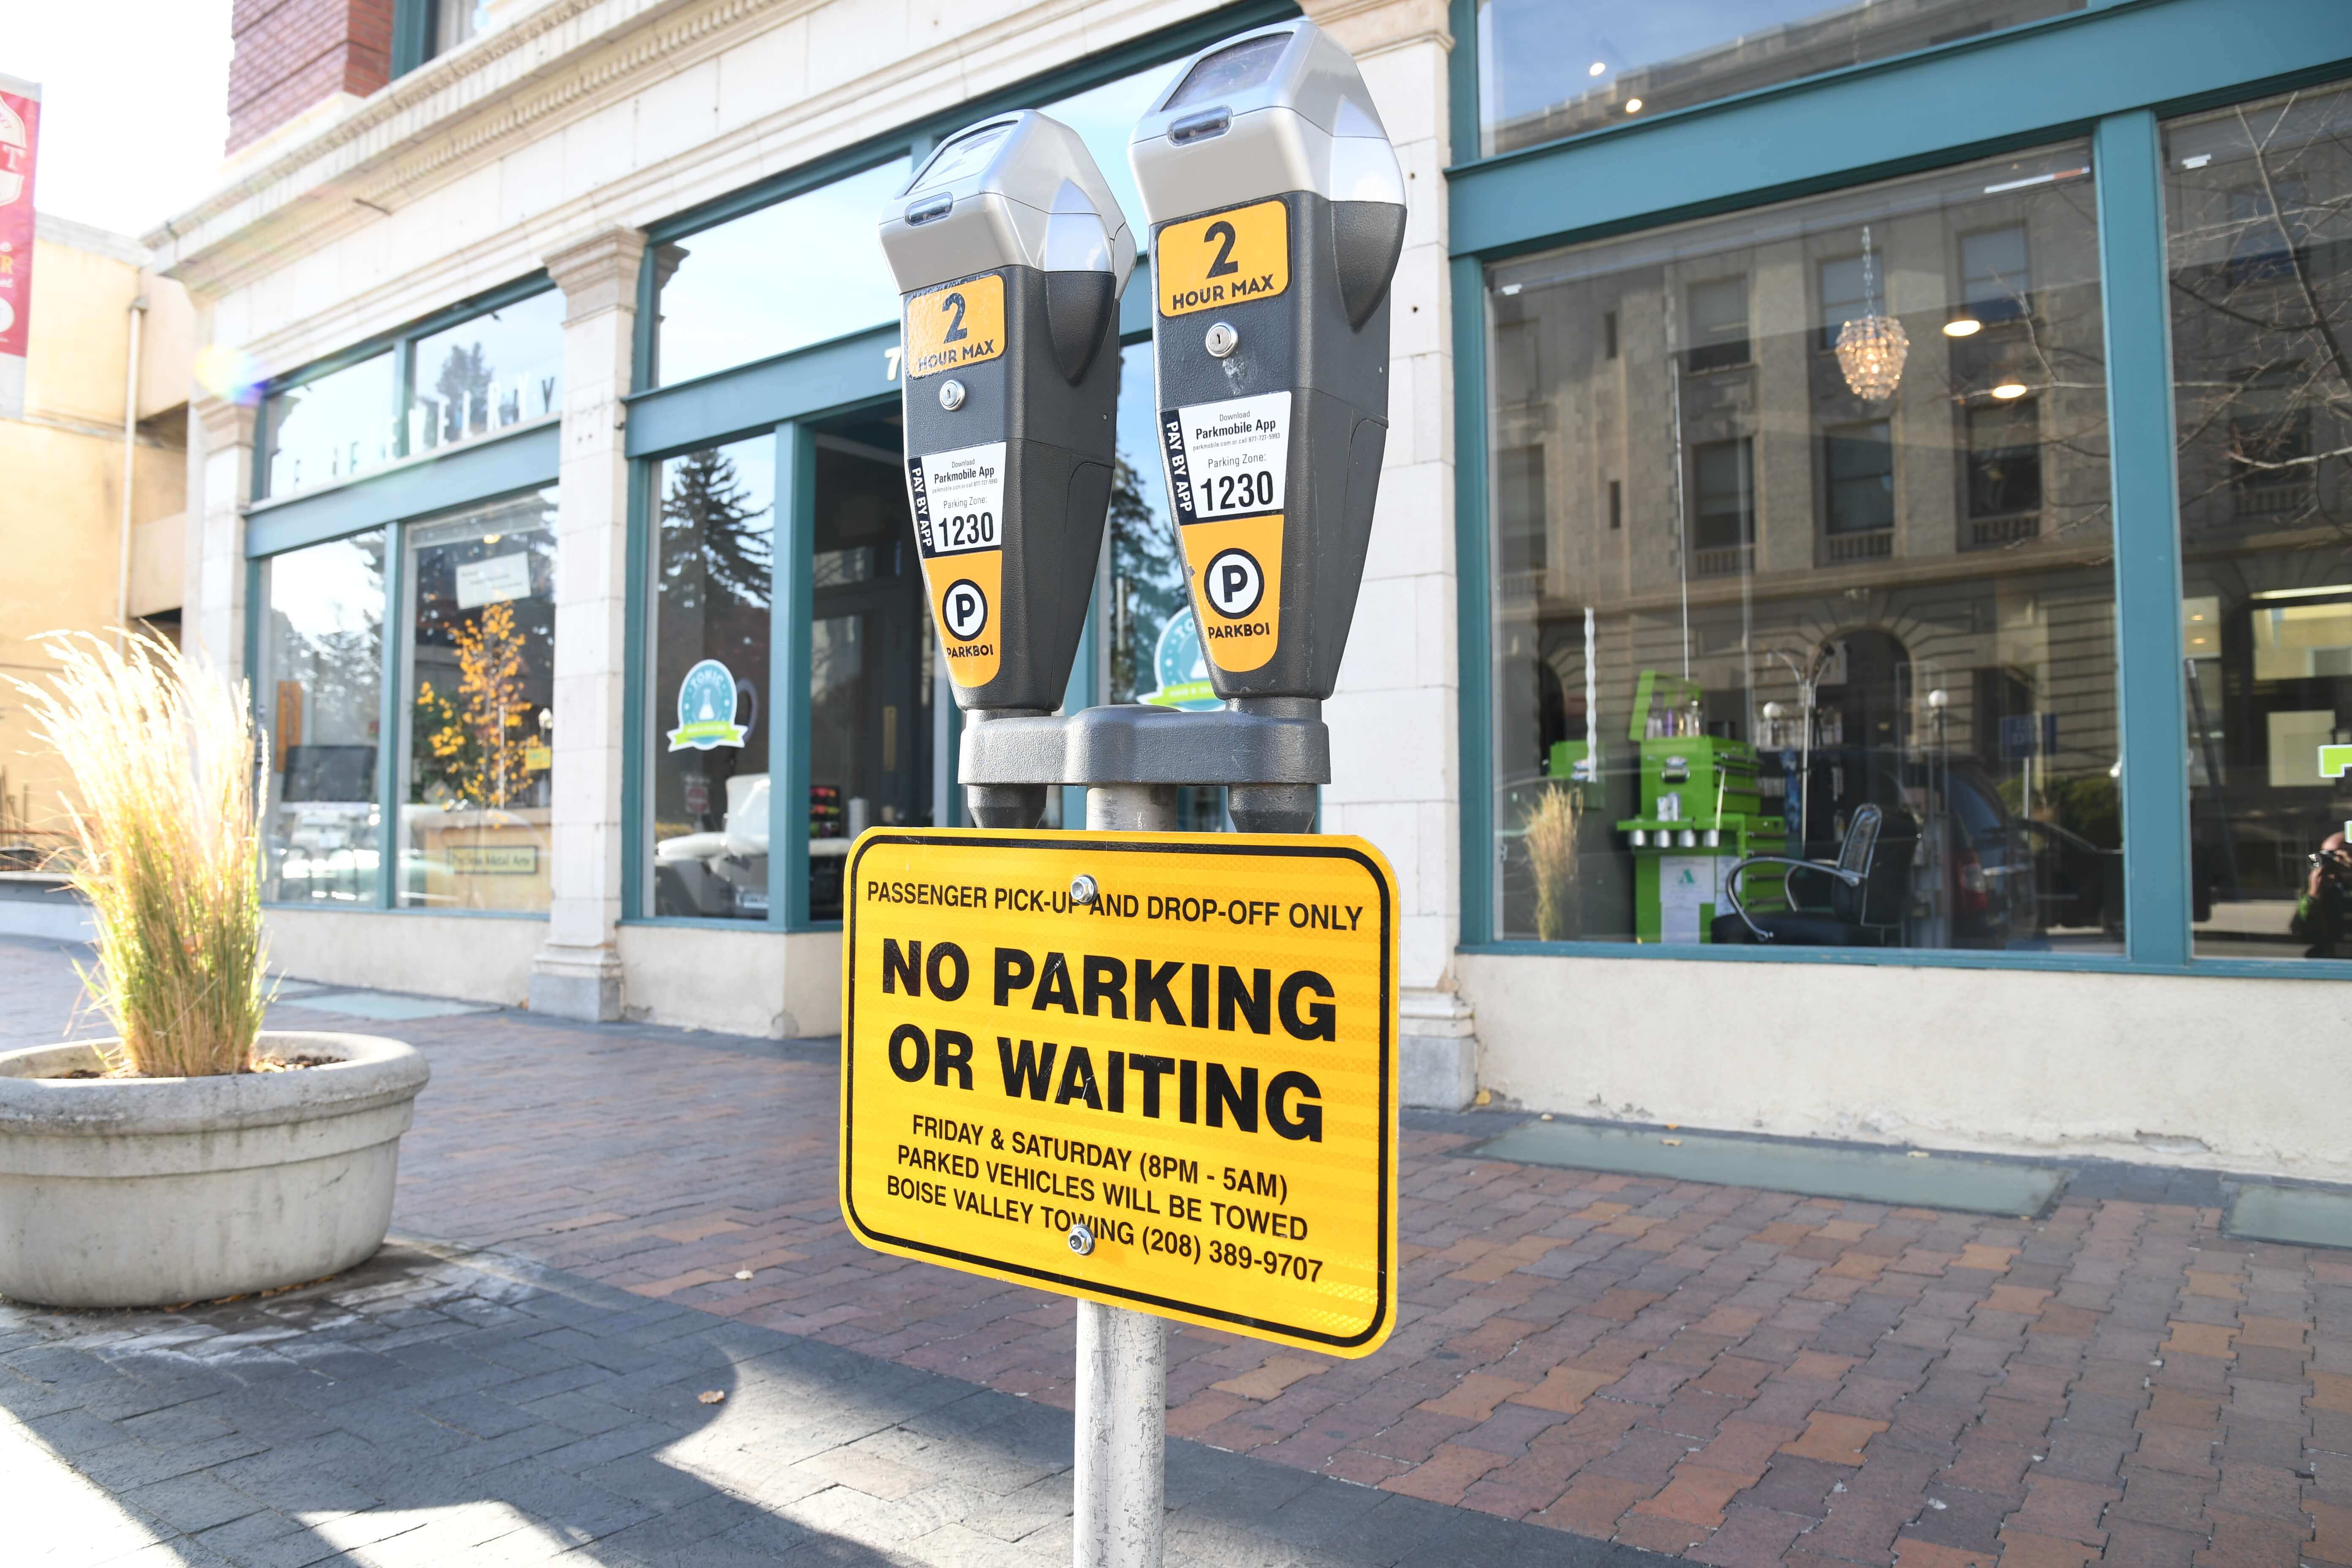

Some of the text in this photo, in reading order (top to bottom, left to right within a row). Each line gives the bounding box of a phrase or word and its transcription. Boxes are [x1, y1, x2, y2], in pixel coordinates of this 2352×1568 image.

[1204, 220, 1239, 280] 2
[1173, 274, 1274, 310] HOUR MAX
[942, 292, 968, 344] 2
[918, 339, 994, 372] HOUR MAX
[368, 372, 530, 460] EWELRY
[1196, 419, 1276, 440] Parkmobile App
[1219, 410, 1250, 422] Download
[1193, 440, 1231, 452] parkmobile.com
[1248, 433, 1280, 443] 877-727-5993
[1208, 453, 1266, 468] Parking Zone:
[934, 466, 994, 484] Parkmobile App
[952, 458, 975, 468] Download
[1166, 421, 1192, 512] PAY BY APP
[912, 467, 932, 547] PAY BY APP
[943, 496, 987, 509] Parking Zone:
[1200, 471, 1274, 511] 1230
[938, 512, 994, 547] 1230
[1222, 564, 1248, 603] P
[956, 593, 975, 627] P
[1208, 622, 1270, 639] PARKBOI
[946, 644, 994, 658] PARKBOI
[690, 670, 724, 688] TONIC
[867, 881, 987, 908] PASSENGER
[1089, 893, 1139, 918] AND
[1147, 896, 1280, 926] DROP-OFF
[1289, 903, 1364, 931] ONLY
[882, 938, 1336, 1042] NO PARKING
[888, 1023, 1323, 1143] OR WAITING
[913, 1114, 983, 1146] FRIDAY
[991, 1128, 1004, 1150] &
[1012, 1131, 1132, 1172] SATURDAY
[1140, 1152, 1198, 1184] (8PM
[1223, 1167, 1288, 1206] 5AM)
[898, 1144, 1308, 1241] PARKED VEHICLES WILL BE TOWED
[887, 1175, 1323, 1283] BOISE VALLEY TOWING (208) 389-9707
